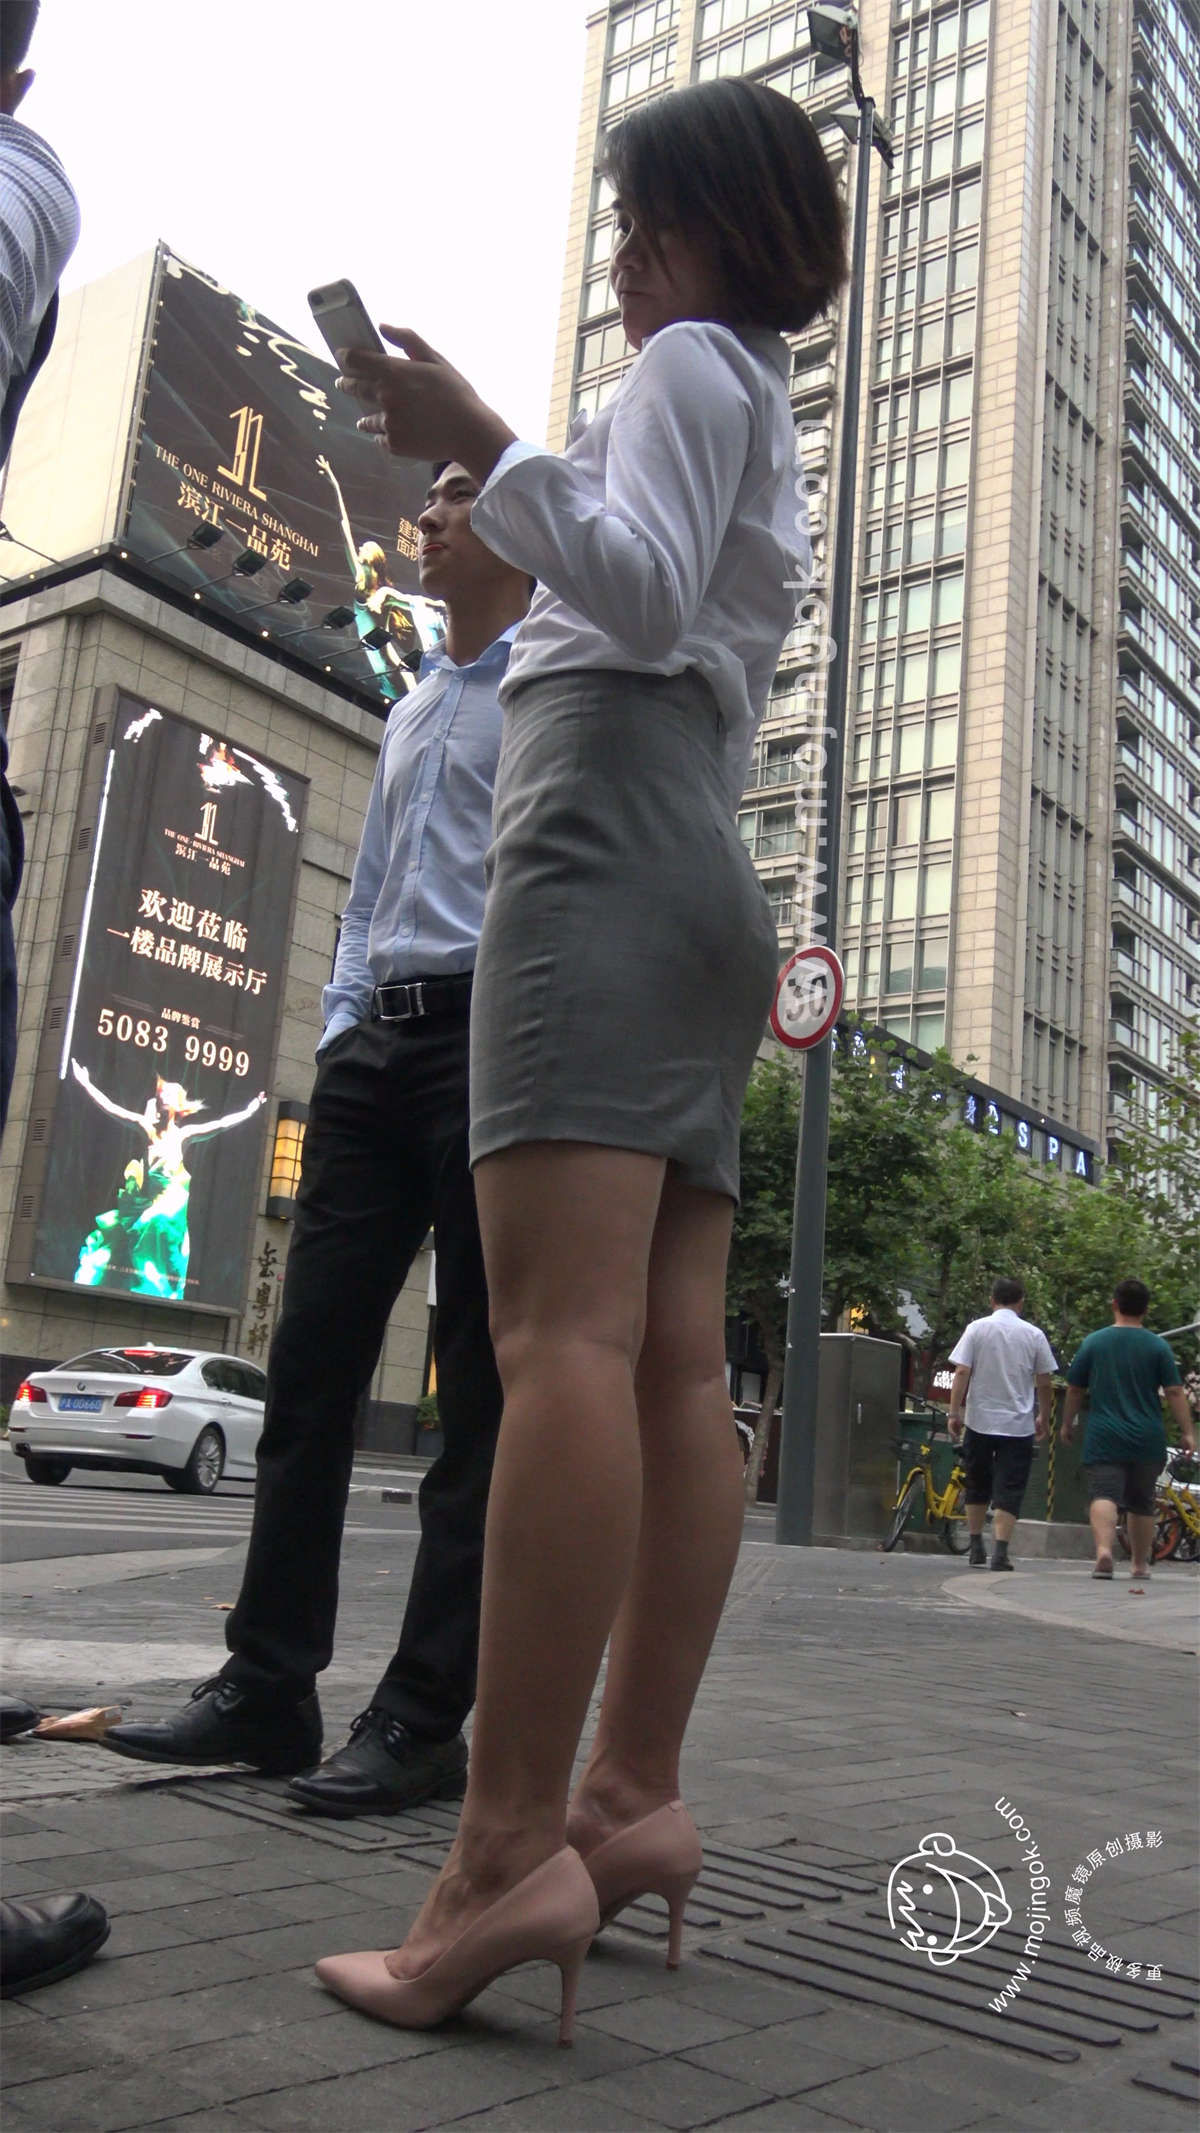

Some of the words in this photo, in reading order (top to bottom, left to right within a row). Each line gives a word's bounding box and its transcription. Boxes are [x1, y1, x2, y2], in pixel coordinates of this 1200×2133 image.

[155, 444, 179, 470] THE
[183, 463, 208, 488] ONE
[212, 481, 258, 521] RIVIERA
[262, 512, 319, 557] SHANGHAI
[177, 481, 291, 571] 滨江一品苑
[138, 888, 248, 953] 欢迎莅临
[106, 926, 267, 995] 一楼品牌展示厅
[97, 1008, 169, 1052] 5083
[185, 1035, 250, 1077] 9999
[1018, 1121, 1086, 1177] SPA
